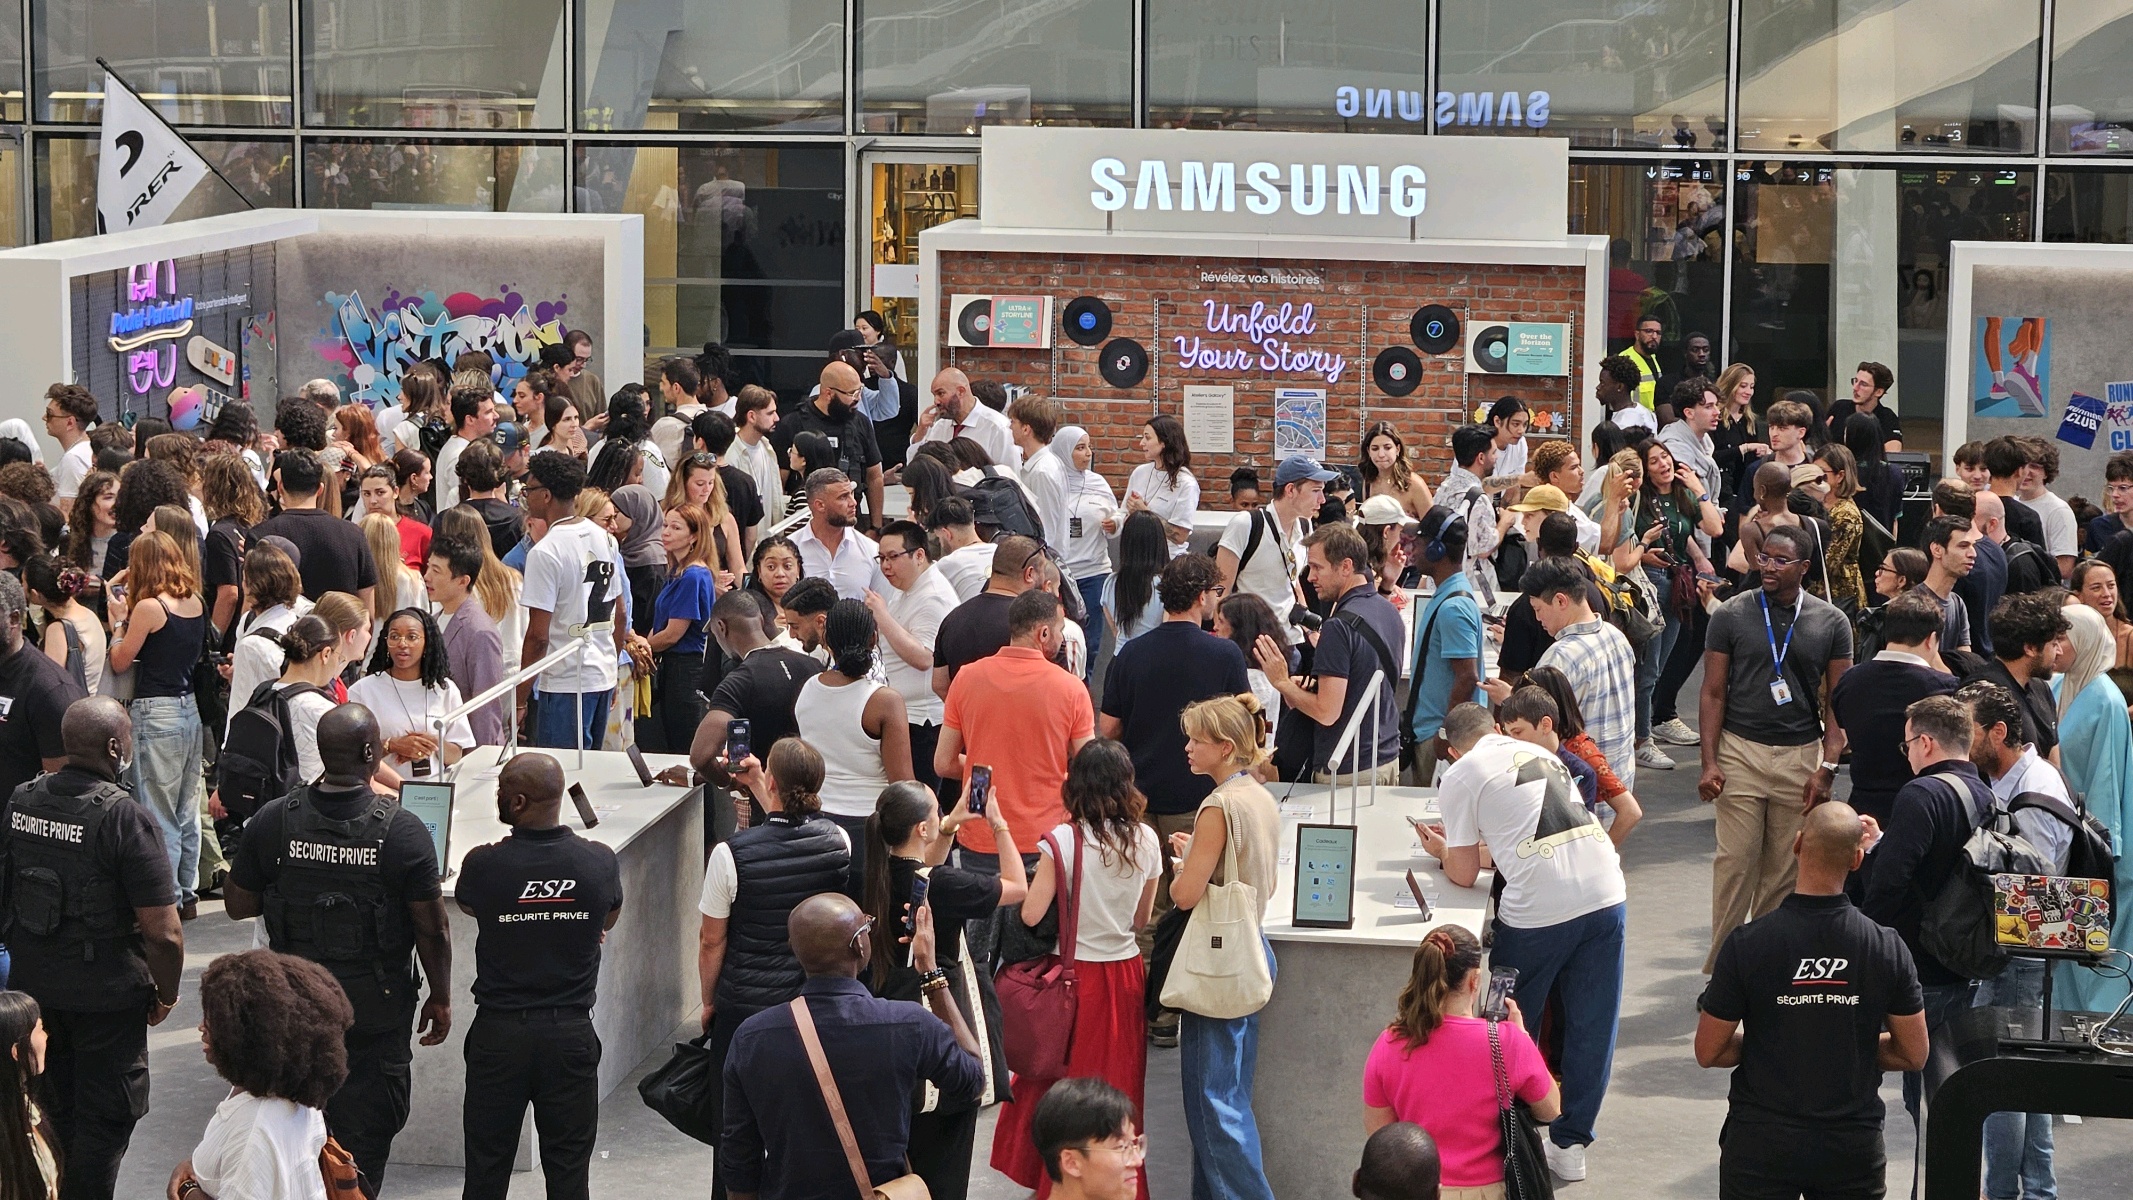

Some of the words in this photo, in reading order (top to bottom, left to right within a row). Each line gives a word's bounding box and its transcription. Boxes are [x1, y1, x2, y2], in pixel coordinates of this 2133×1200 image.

[1090, 157, 1427, 218] SAMSUNG
[1200, 272, 1246, 284] Révélez
[1248, 275, 1269, 284] vos
[1270, 274, 1320, 285] histoires
[1001, 311, 1034, 319] STORYLINE
[1203, 299, 1317, 344] Unfold
[1430, 323, 1441, 335] 7
[1519, 332, 1539, 340] Over
[1540, 333, 1553, 341] the
[1173, 335, 1254, 371] Your
[1259, 337, 1347, 384] Story
[2065, 412, 2098, 431] CLUB
[11, 811, 49, 838] SECURITE
[49, 820, 84, 844] PRIVEE
[289, 840, 338, 864] SECURITE
[339, 847, 377, 866] PRIVEE
[518, 879, 577, 899] ESP
[1792, 957, 1849, 980] ESP
